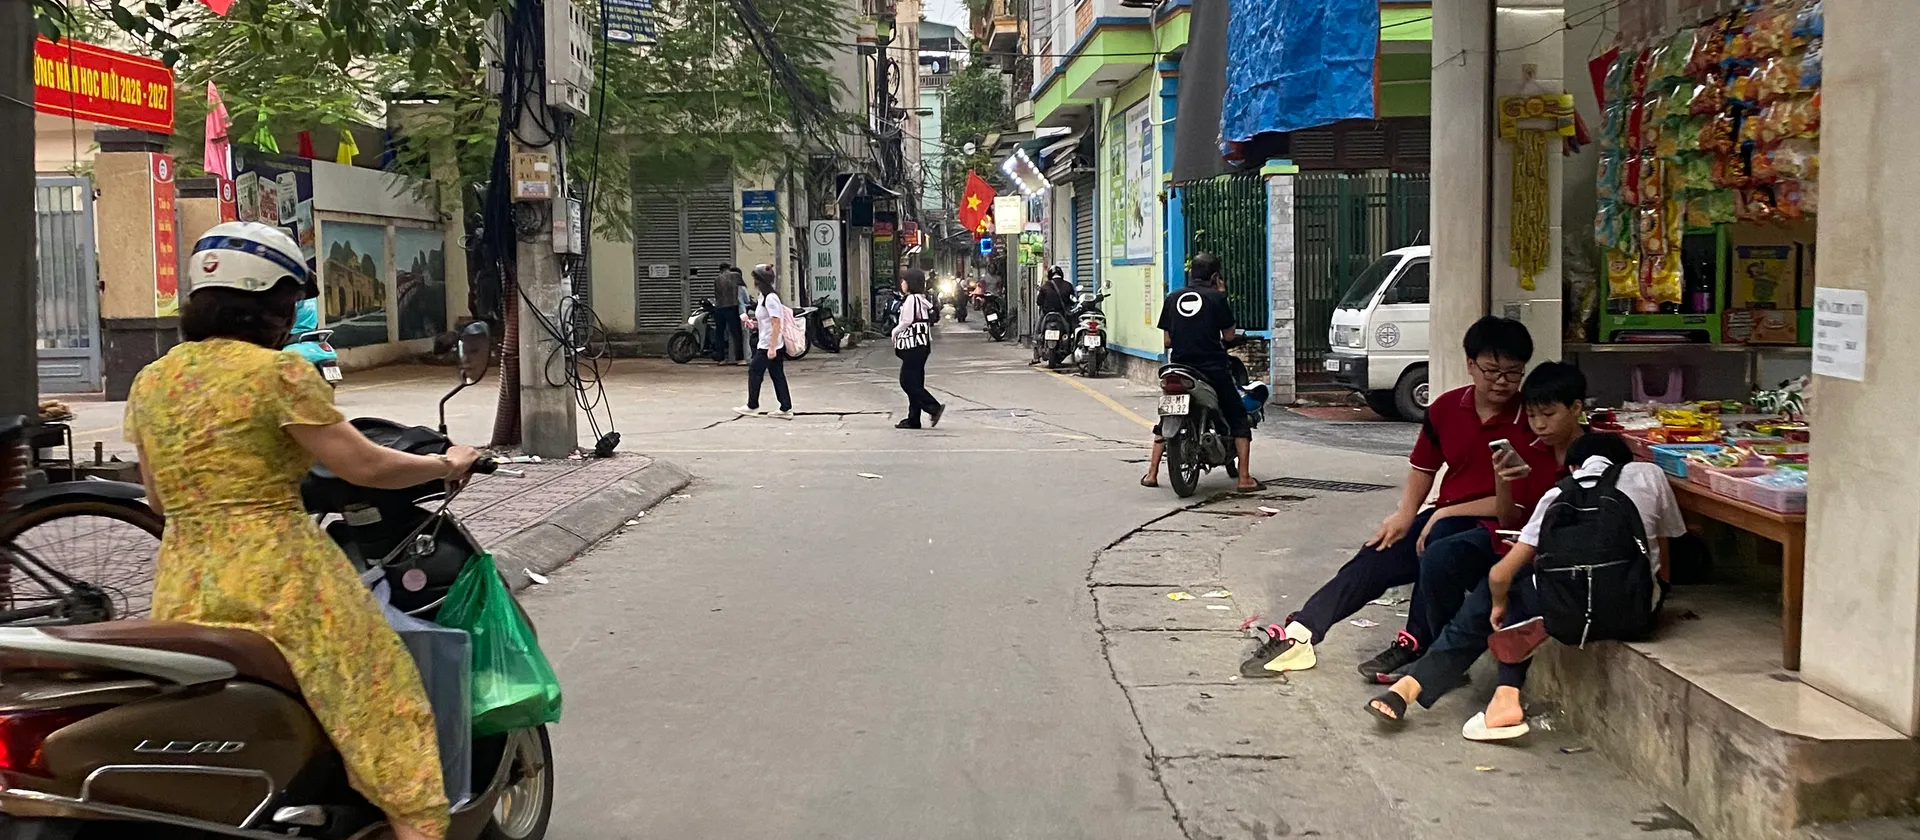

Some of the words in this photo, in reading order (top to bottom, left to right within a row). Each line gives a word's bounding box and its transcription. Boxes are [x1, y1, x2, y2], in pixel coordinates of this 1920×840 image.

[56, 58, 79, 93] NĂM
[80, 66, 100, 102] HỌC
[101, 68, 119, 101] MỚI
[120, 76, 142, 106] 2026
[148, 82, 168, 110] 2027
[818, 249, 832, 268] NHÀ
[815, 270, 836, 291] THUỐC
[1162, 395, 1185, 405] 29-M1
[134, 740, 245, 753] LEAD
